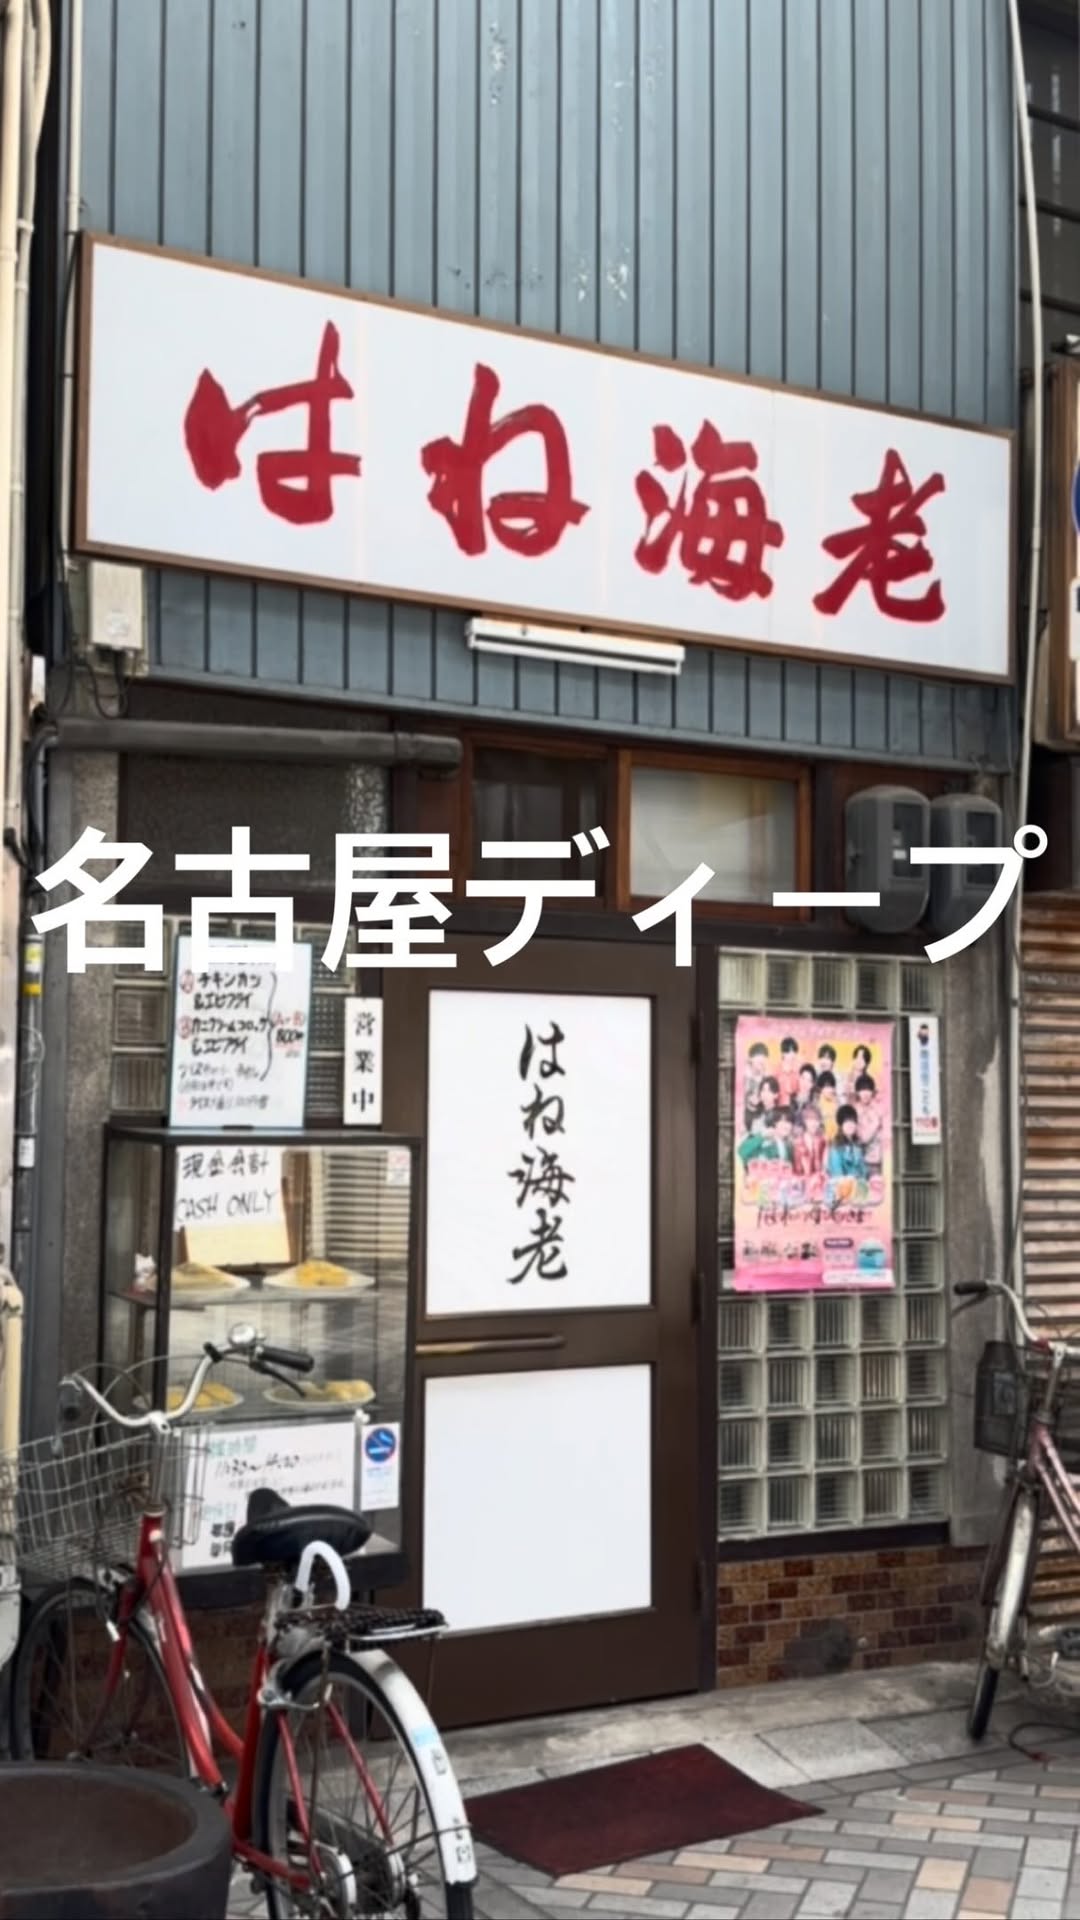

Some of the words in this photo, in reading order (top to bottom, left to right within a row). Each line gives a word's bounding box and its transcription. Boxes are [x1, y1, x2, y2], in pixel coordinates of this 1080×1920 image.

[183, 319, 947, 626] はね海老
[197, 971, 263, 990] チキンカツ
[351, 1010, 376, 1112] 営業中
[181, 1148, 271, 1180] 現金会計
[506, 1020, 576, 1285] はね海老
[176, 1192, 220, 1223] CASH
[226, 1188, 278, 1217] ONLY
